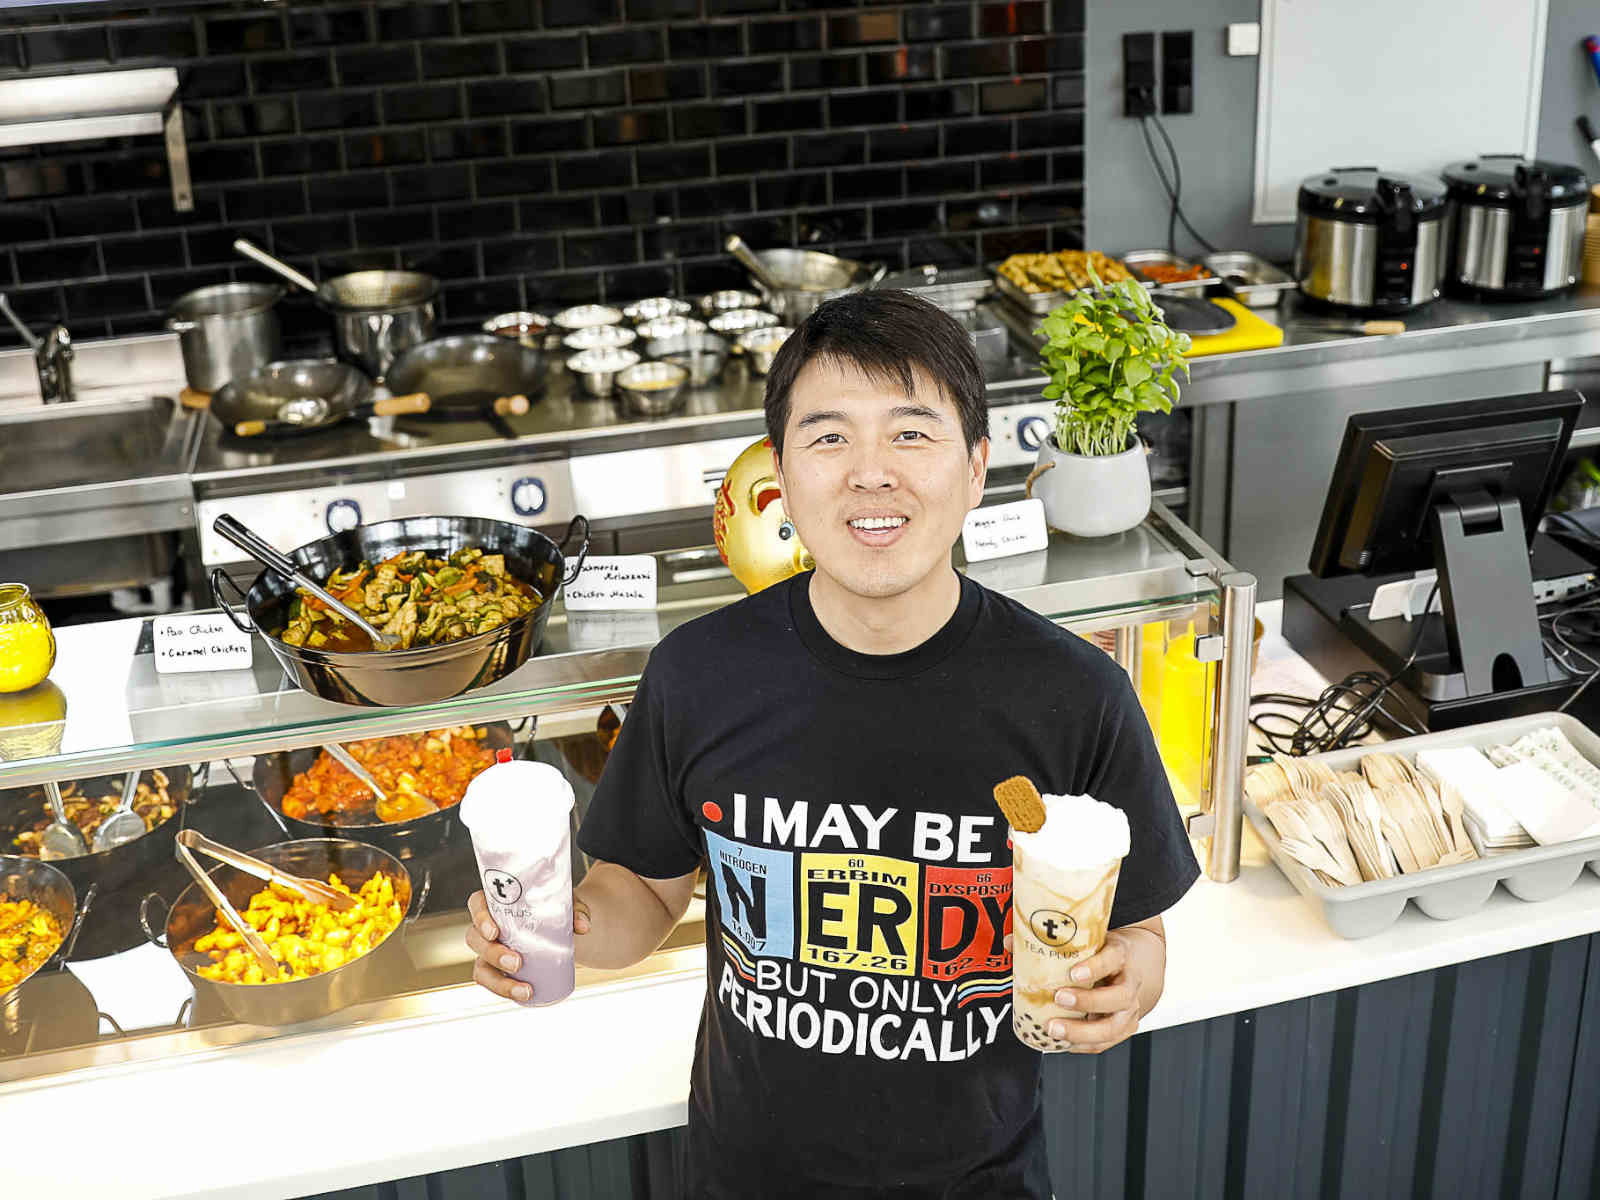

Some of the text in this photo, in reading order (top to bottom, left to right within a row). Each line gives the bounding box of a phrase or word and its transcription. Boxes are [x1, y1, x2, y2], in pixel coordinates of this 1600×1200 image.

[189, 623, 224, 635] Chicken
[168, 644, 248, 658] Caramel Chicken
[733, 792, 995, 863] I MAY BE
[719, 848, 768, 875] NITROGEN
[737, 847, 743, 857] 7
[847, 858, 865, 868] 60
[807, 869, 908, 887] ERBIM
[976, 873, 992, 883] 66
[807, 947, 908, 970] 167.26
[1024, 939, 1080, 960] TEA PLUS
[756, 959, 957, 1016] BUT ONLY
[718, 960, 1012, 1062] PERIODICALLY
